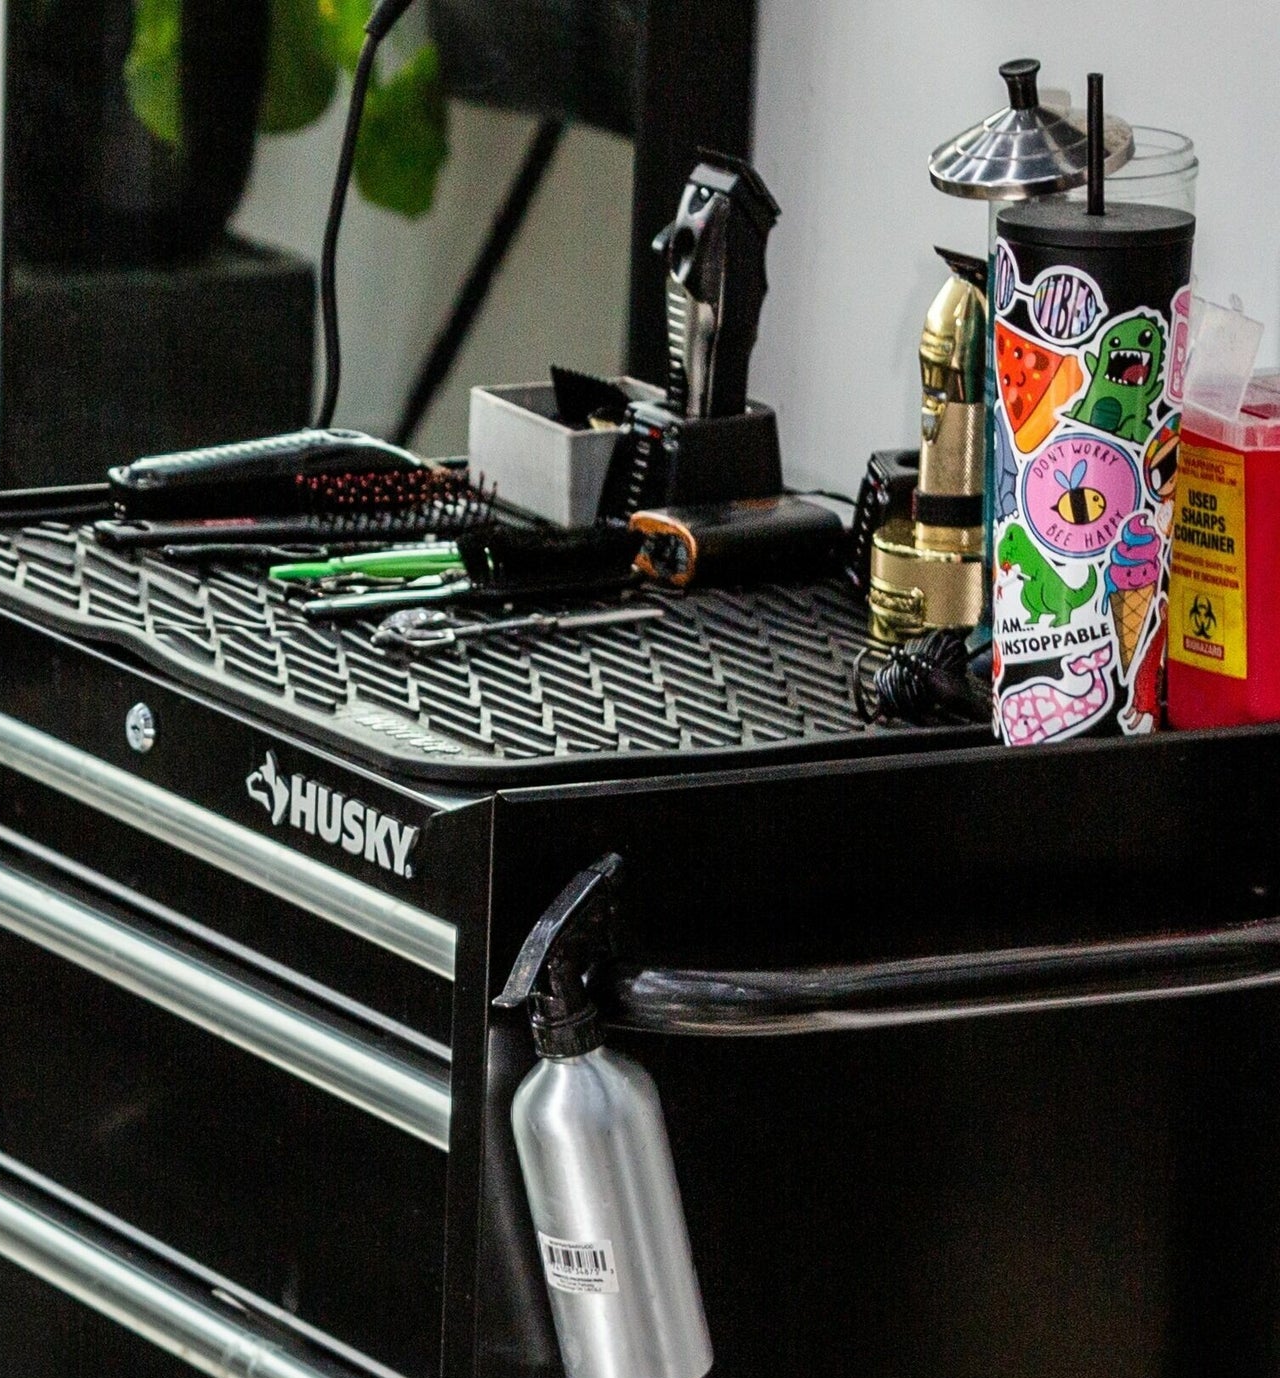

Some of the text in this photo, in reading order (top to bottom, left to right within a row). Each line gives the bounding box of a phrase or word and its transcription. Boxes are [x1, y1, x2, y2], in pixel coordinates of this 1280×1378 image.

[1071, 443, 1119, 466] WORRY
[1188, 488, 1217, 511] USED
[1046, 510, 1124, 548] BEE HAPPY
[1182, 507, 1225, 532] SHARPS
[1174, 523, 1235, 555] CONTAINER
[1002, 617, 1034, 633] AM...
[290, 773, 418, 876] HUSKY
